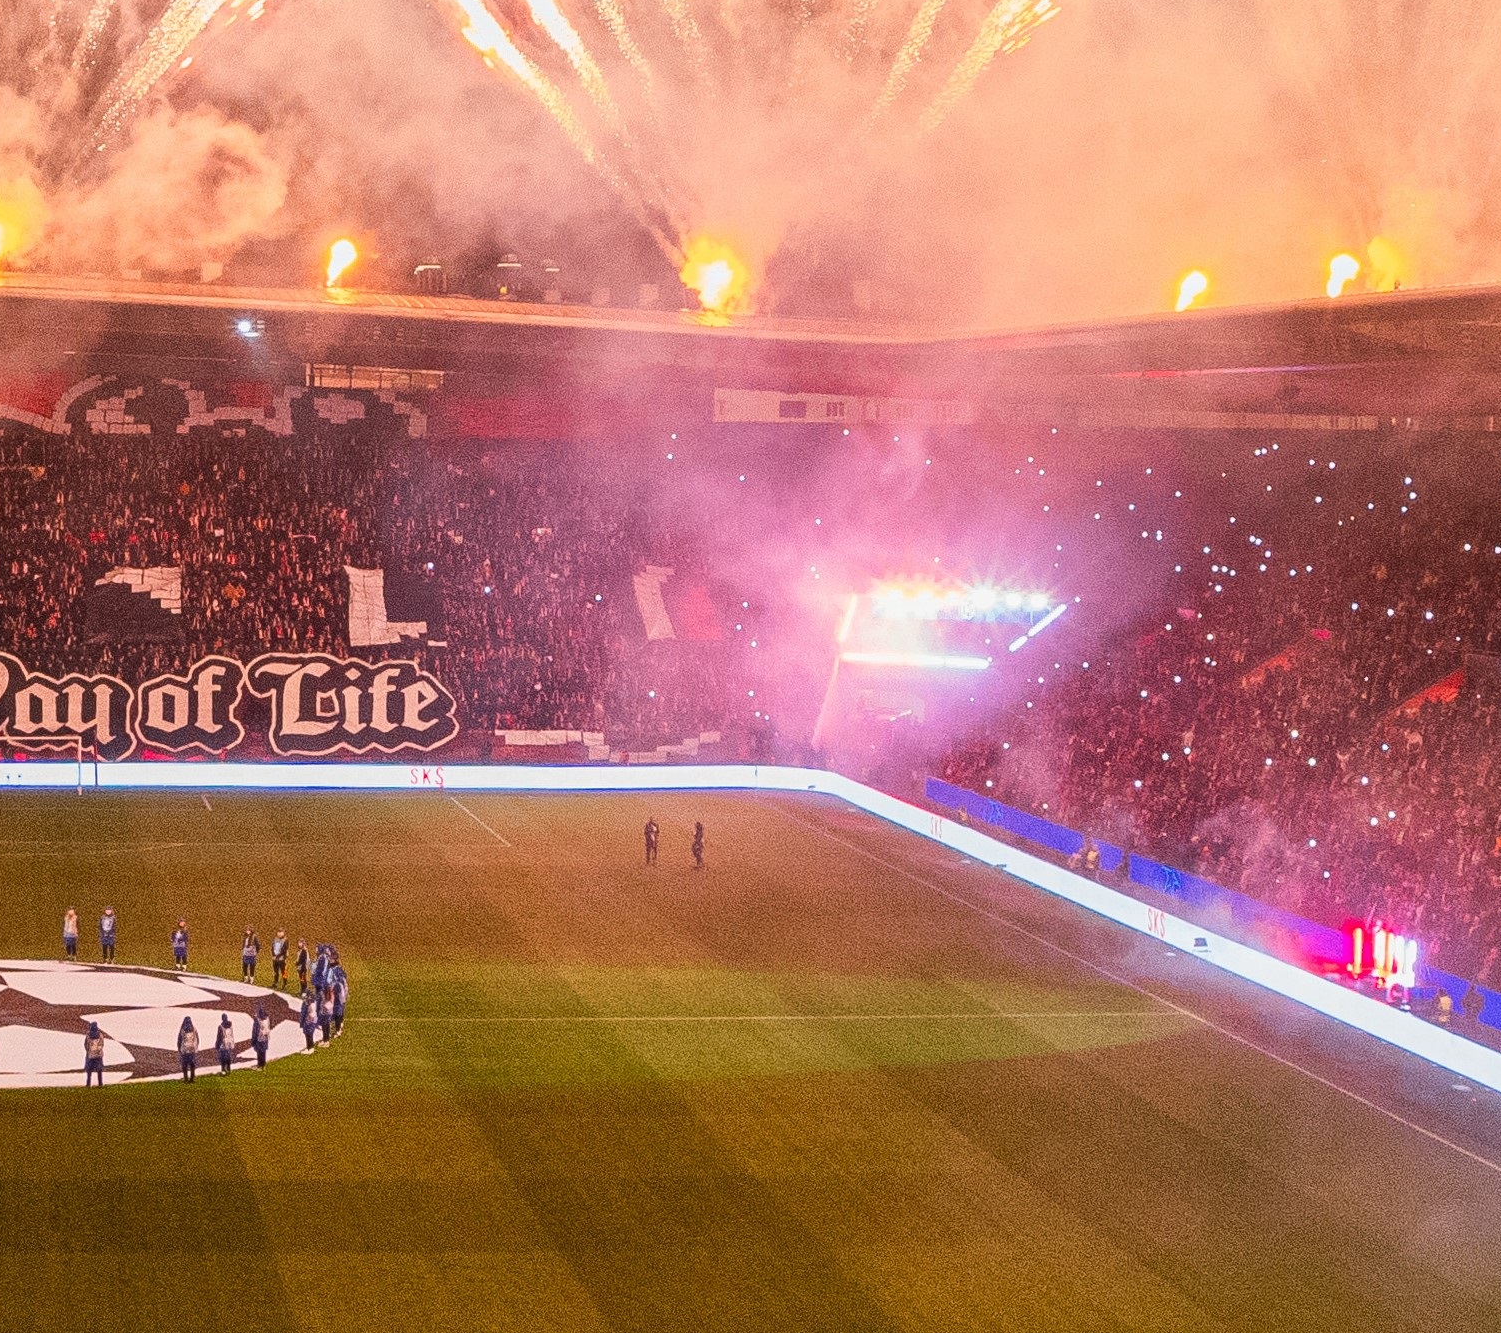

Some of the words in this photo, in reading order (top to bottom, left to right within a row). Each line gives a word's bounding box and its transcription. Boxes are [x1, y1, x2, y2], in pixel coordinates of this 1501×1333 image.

[144, 664, 227, 734] of
[253, 661, 441, 737] Life
[410, 765, 444, 787] SKS
